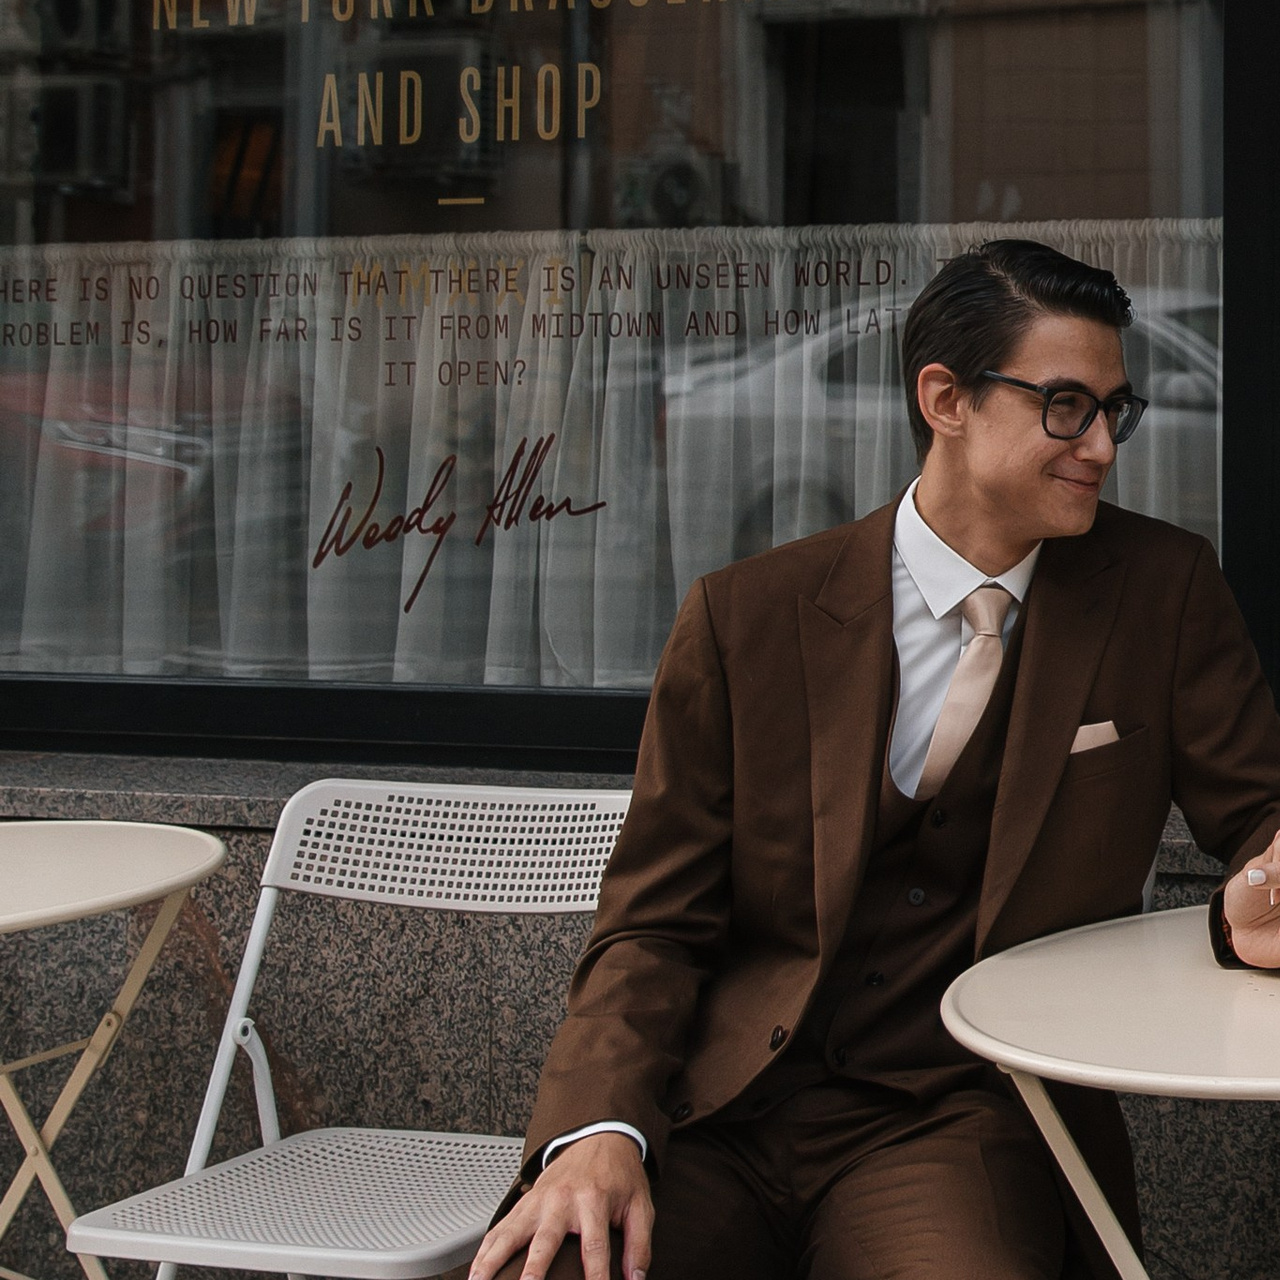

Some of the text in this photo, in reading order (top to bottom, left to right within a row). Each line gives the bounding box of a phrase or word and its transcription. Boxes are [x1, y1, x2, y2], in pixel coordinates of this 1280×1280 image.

[317, 63, 601, 148] AND SHOP
[79, 276, 110, 302] IS
[128, 275, 160, 300] NO
[179, 272, 317, 301] QUESTION
[338, 269, 409, 296] THAT
[429, 267, 518, 295] THERE
[543, 266, 576, 293] IS
[598, 265, 634, 291] AN
[656, 262, 771, 290] UNSEEN
[794, 260, 908, 288] WORLD.
[120, 320, 167, 349] IS,
[188, 318, 238, 344] HOW
[259, 317, 308, 342] FAR
[330, 316, 363, 341] IS
[385, 315, 417, 341] IT
[439, 314, 509, 340] FROM
[532, 312, 662, 338] MIDTOWN
[685, 310, 740, 336] AND
[764, 309, 821, 336] HOW
[847, 308, 902, 334] LAT
[385, 359, 527, 387] IT OPEN?
